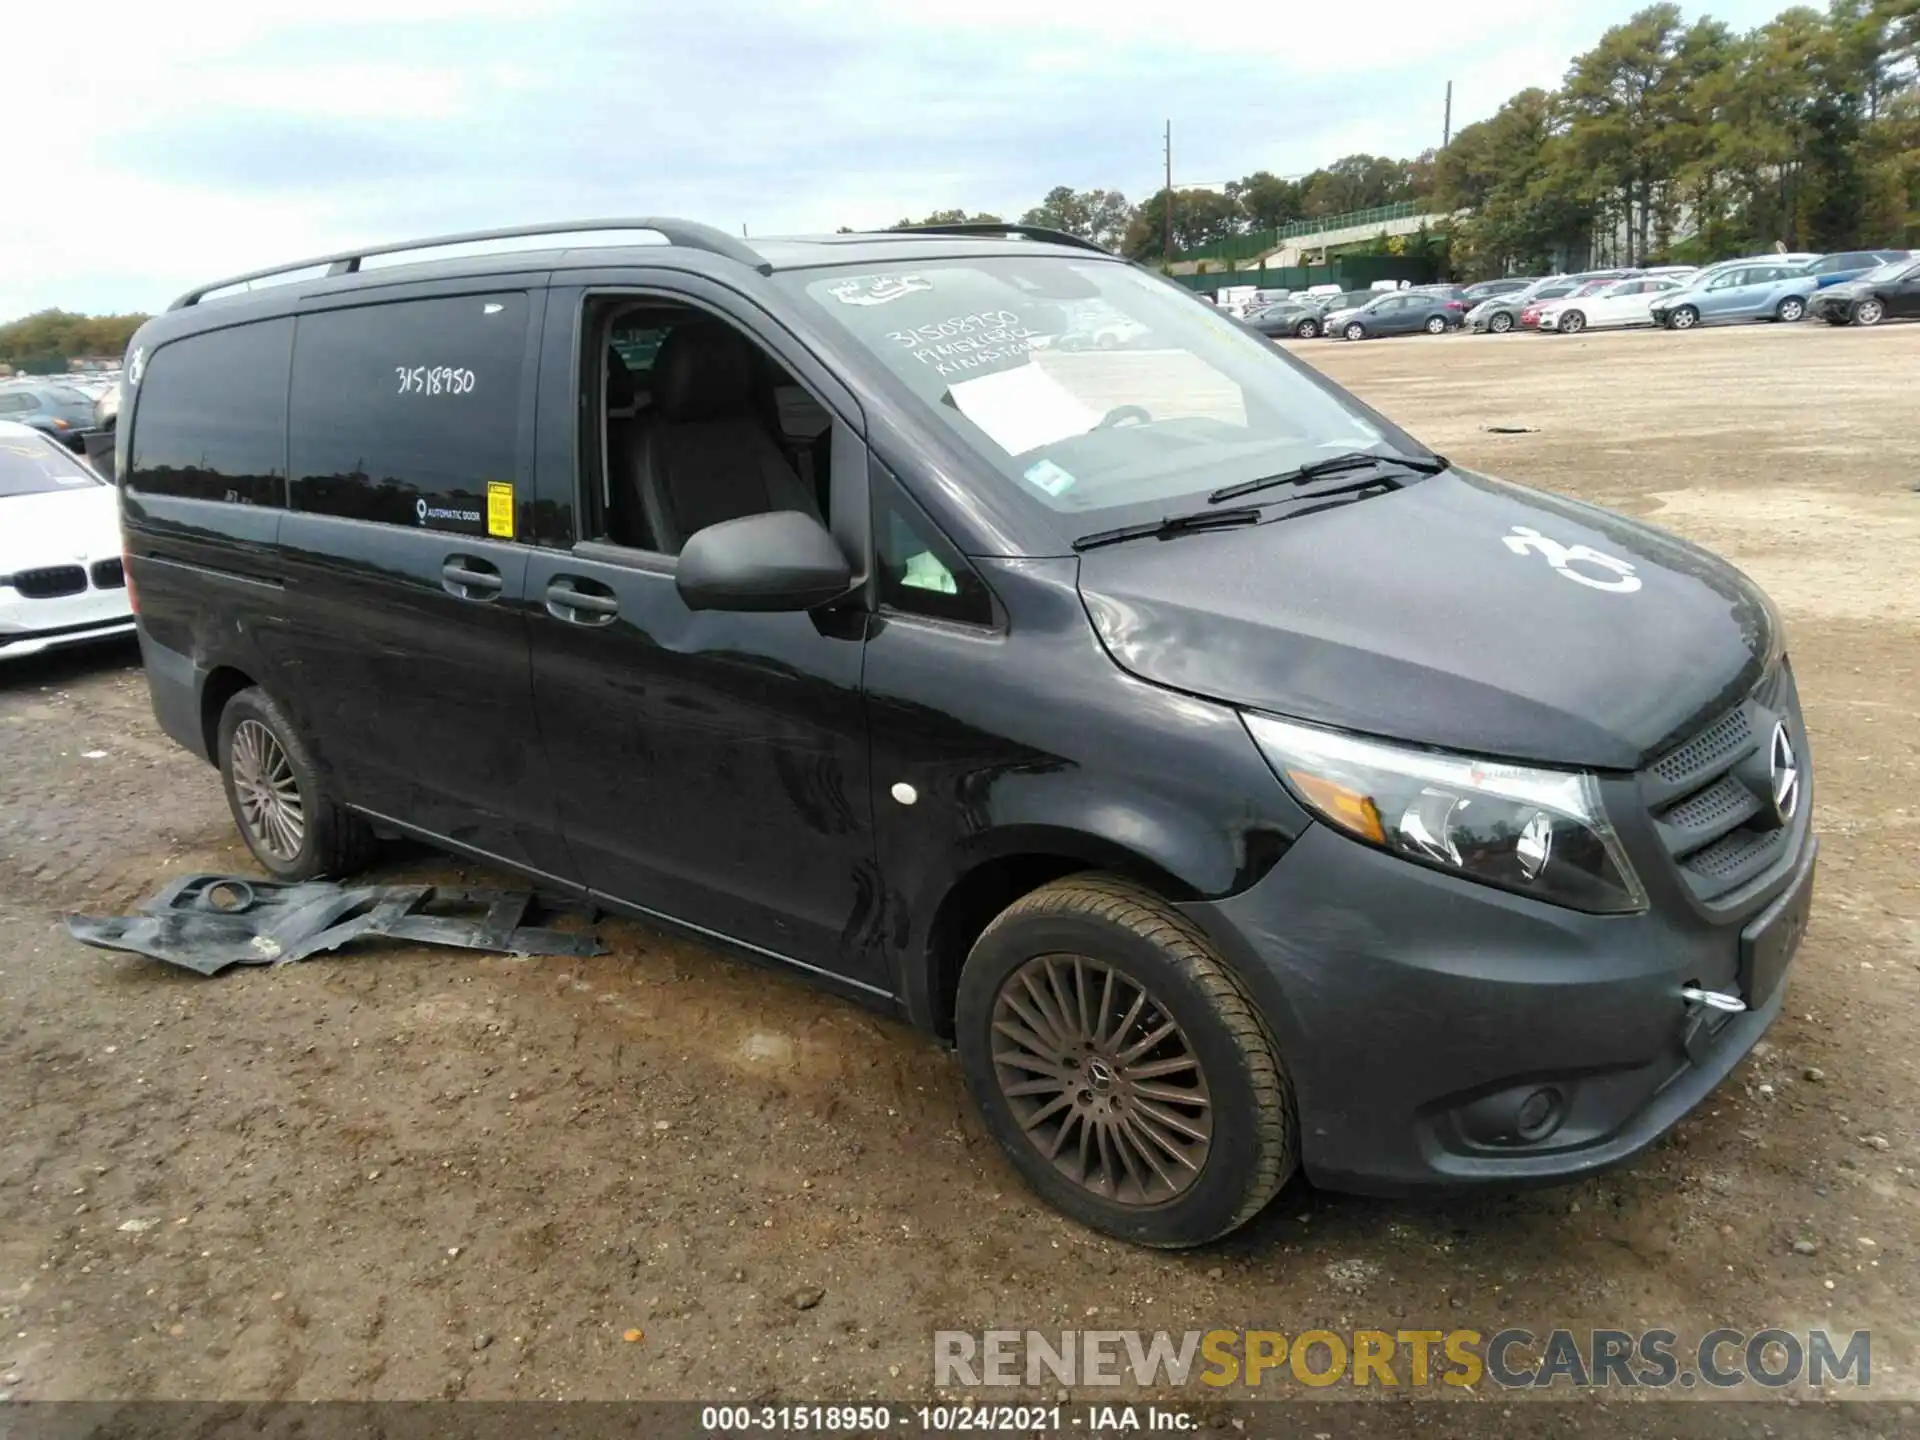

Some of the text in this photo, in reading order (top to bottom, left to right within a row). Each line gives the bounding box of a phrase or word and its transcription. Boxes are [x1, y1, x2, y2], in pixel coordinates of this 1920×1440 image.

[395, 366, 475, 396] 31518950
[427, 507, 481, 521] AUTOMATIC DOOR
